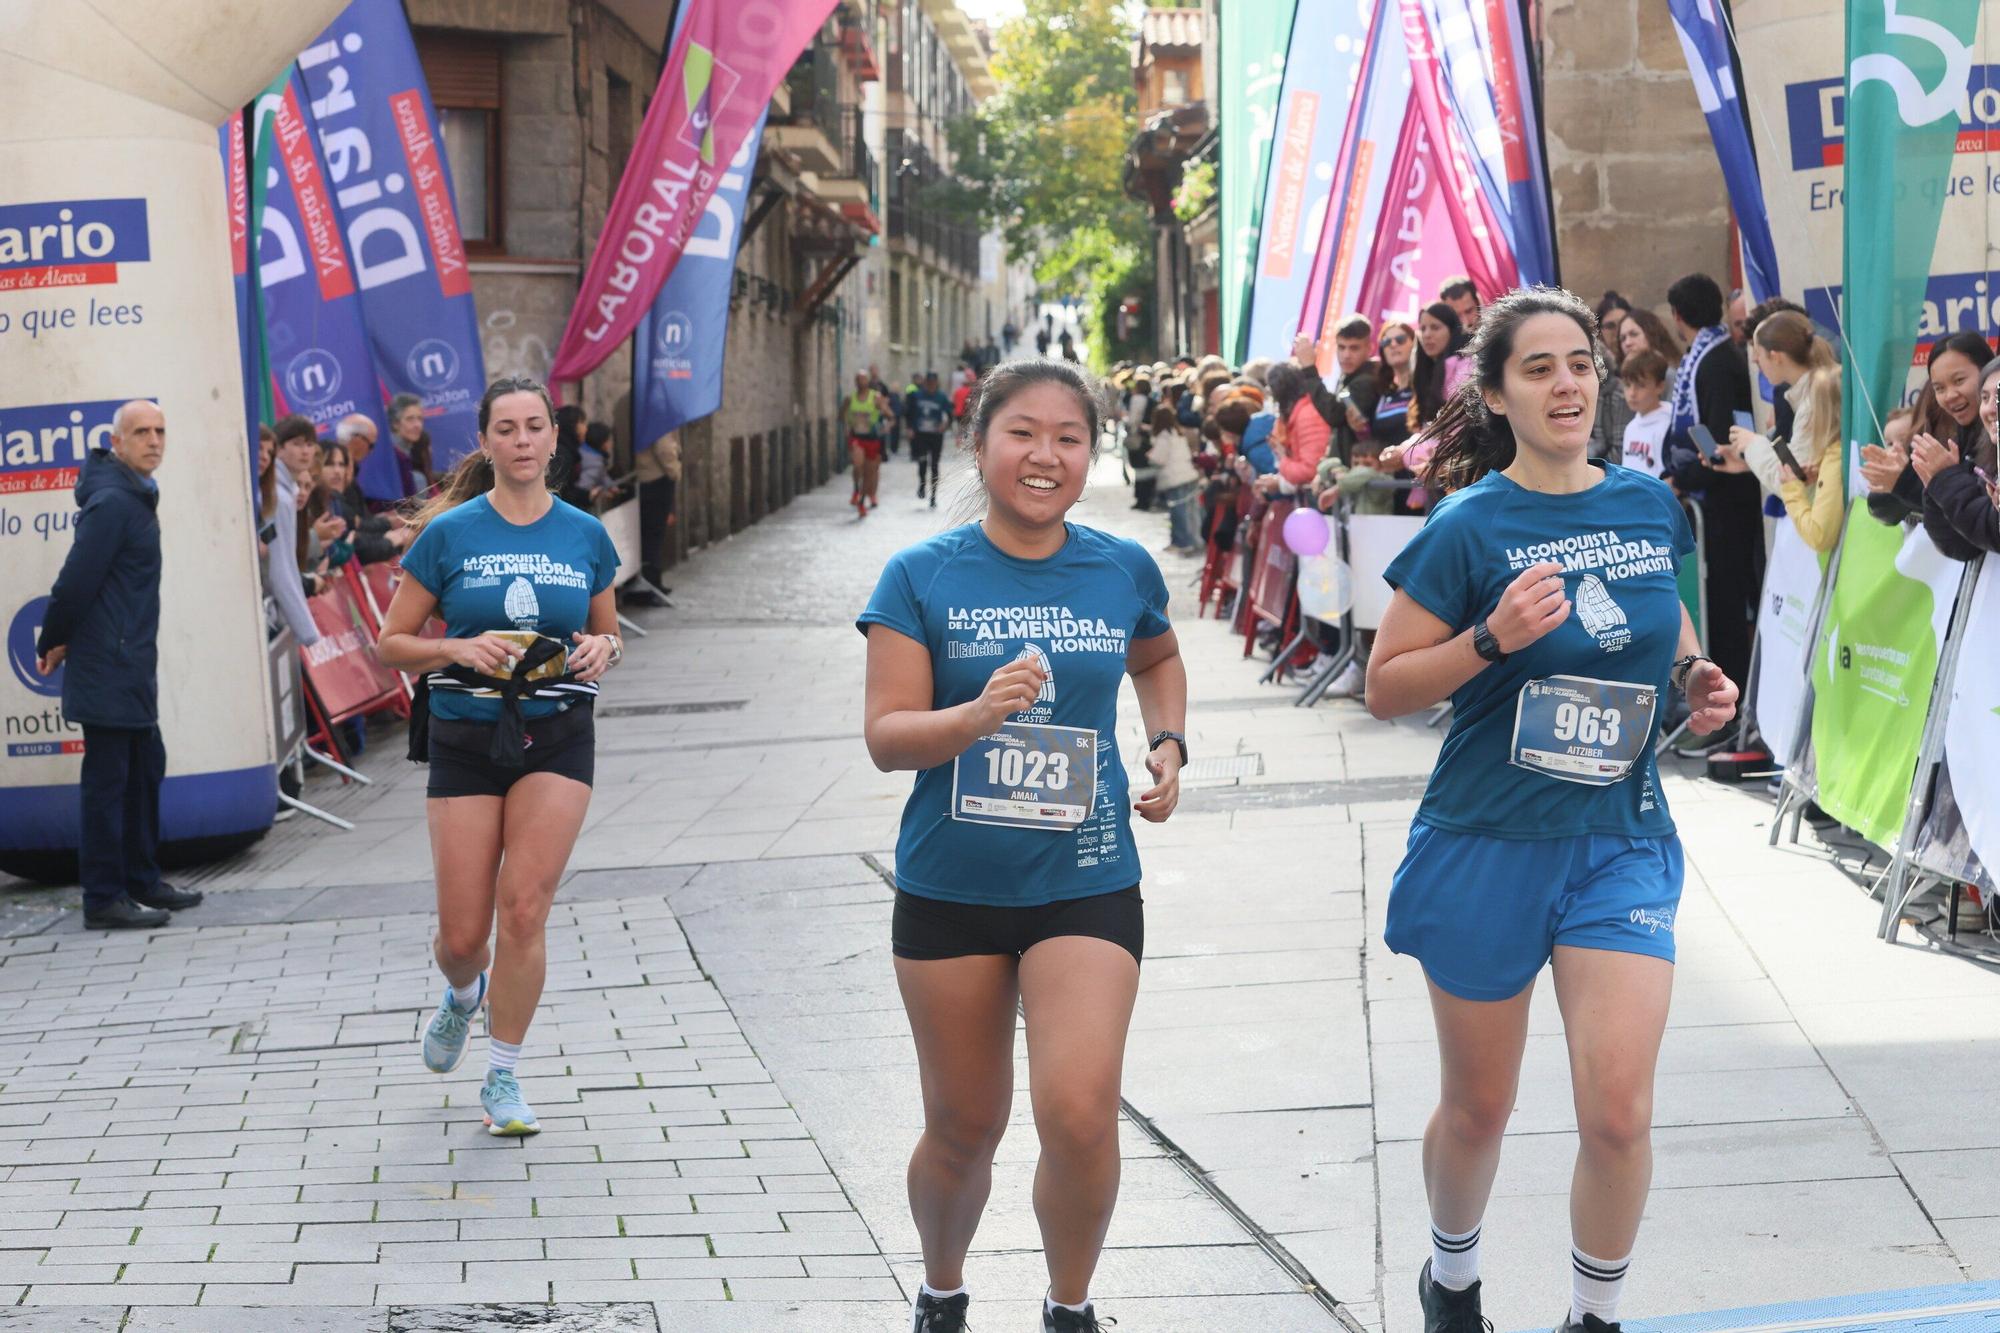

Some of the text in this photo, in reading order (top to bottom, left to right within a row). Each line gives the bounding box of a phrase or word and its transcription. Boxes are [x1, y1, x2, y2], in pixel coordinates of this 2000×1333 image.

[584, 159, 700, 342] LABORAL
[19, 272, 36, 287] de
[39, 266, 87, 286] Álava
[22, 308, 76, 339] que
[89, 298, 143, 326] lees
[30, 475, 48, 489] de
[1, 508, 21, 536] lo
[1506, 530, 1621, 562] LA CONQUISTA
[464, 554, 550, 566] LA CONQUISTA
[1509, 561, 1525, 570] DE
[482, 562, 575, 577] ALMENDRA
[1606, 556, 1674, 582] KONKISTA
[534, 574, 588, 590] KONKISTA
[948, 606, 1073, 622] LA CONQUISTA
[948, 618, 1126, 641] DE LA ALMENDRA REN
[1597, 627, 1632, 640] VITORIA
[959, 640, 1004, 658] Edición
[1050, 638, 1126, 654] KONKISTA
[1599, 636, 1632, 649] GASTEIZ
[1635, 694, 1650, 705] 5K
[1017, 714, 1051, 724] GASTEIZ
[1553, 702, 1621, 747] 963
[16, 744, 53, 755] GRUPO
[1076, 737, 1089, 748] 5K
[1566, 745, 1604, 758] AITZIBER
[984, 747, 1070, 791] 1023
[1010, 790, 1039, 802] AMAIA
